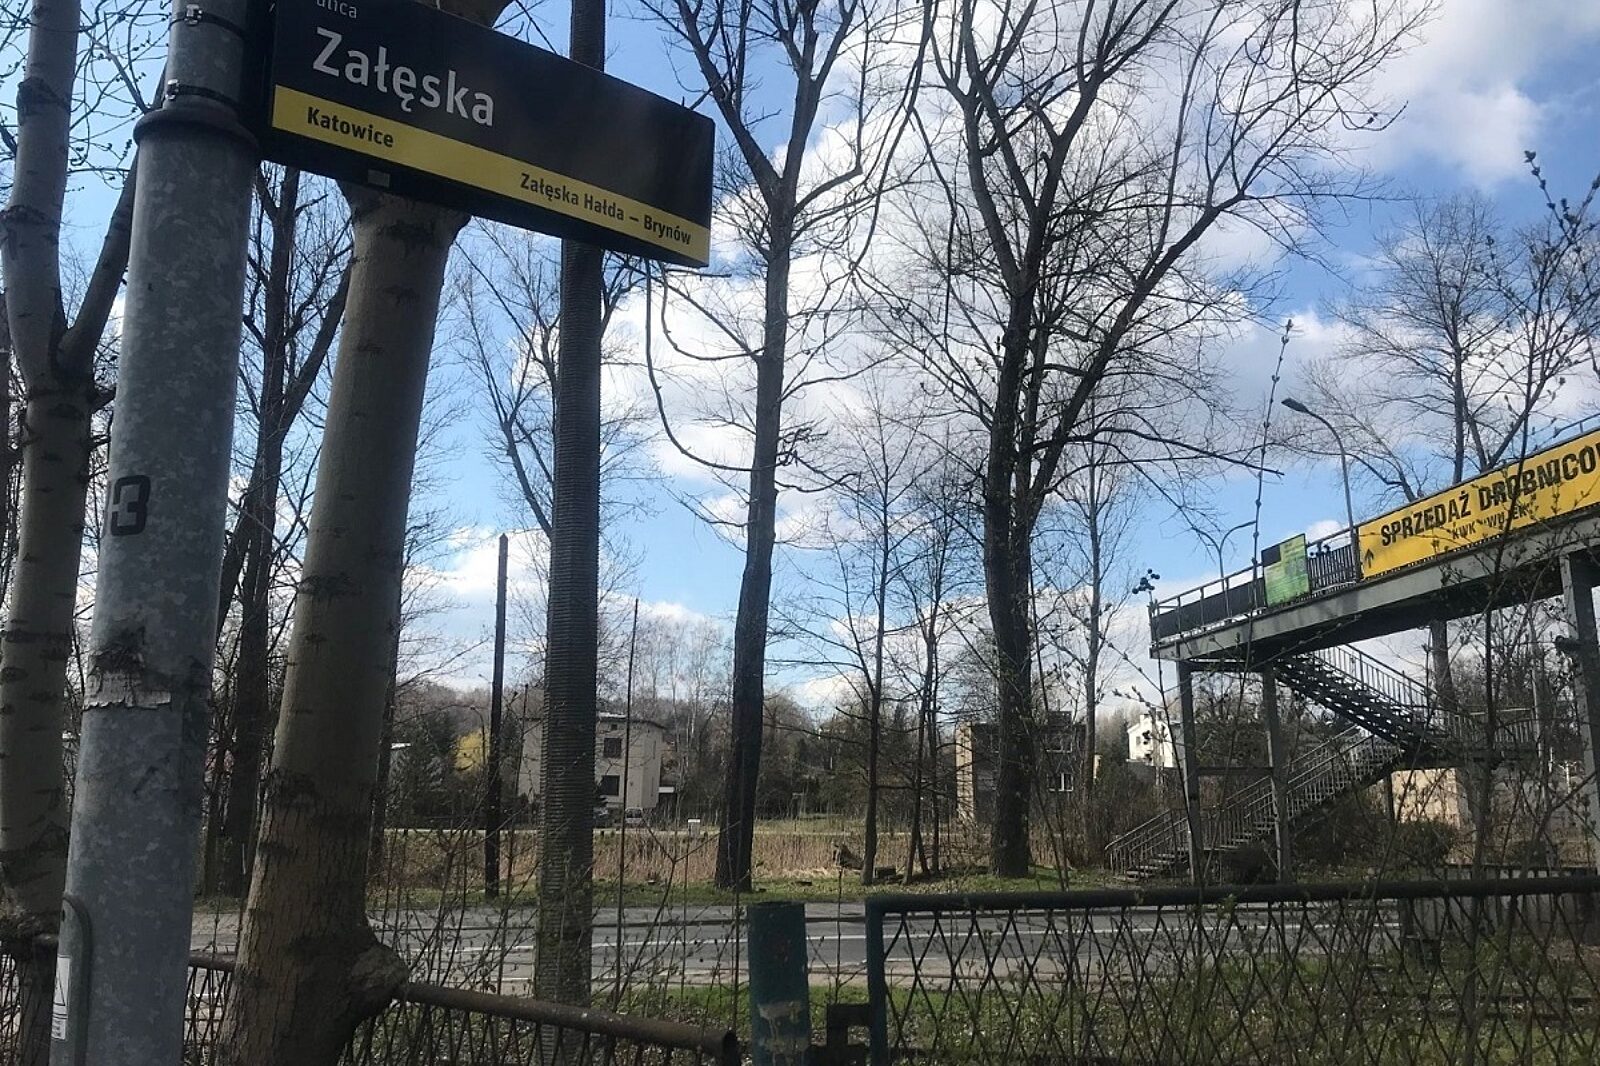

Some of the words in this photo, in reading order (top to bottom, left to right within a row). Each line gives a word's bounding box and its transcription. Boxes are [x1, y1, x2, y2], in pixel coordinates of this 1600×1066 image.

[312, 26, 495, 127] Załęska
[307, 107, 394, 148] Katowice
[520, 172, 579, 202] Załęska
[583, 193, 624, 221] Hałda
[643, 214, 692, 245] Brynów
[110, 474, 151, 536] 3
[1381, 490, 1472, 547] SPRZEDAŻ
[1478, 442, 1600, 511] DROBNICO
